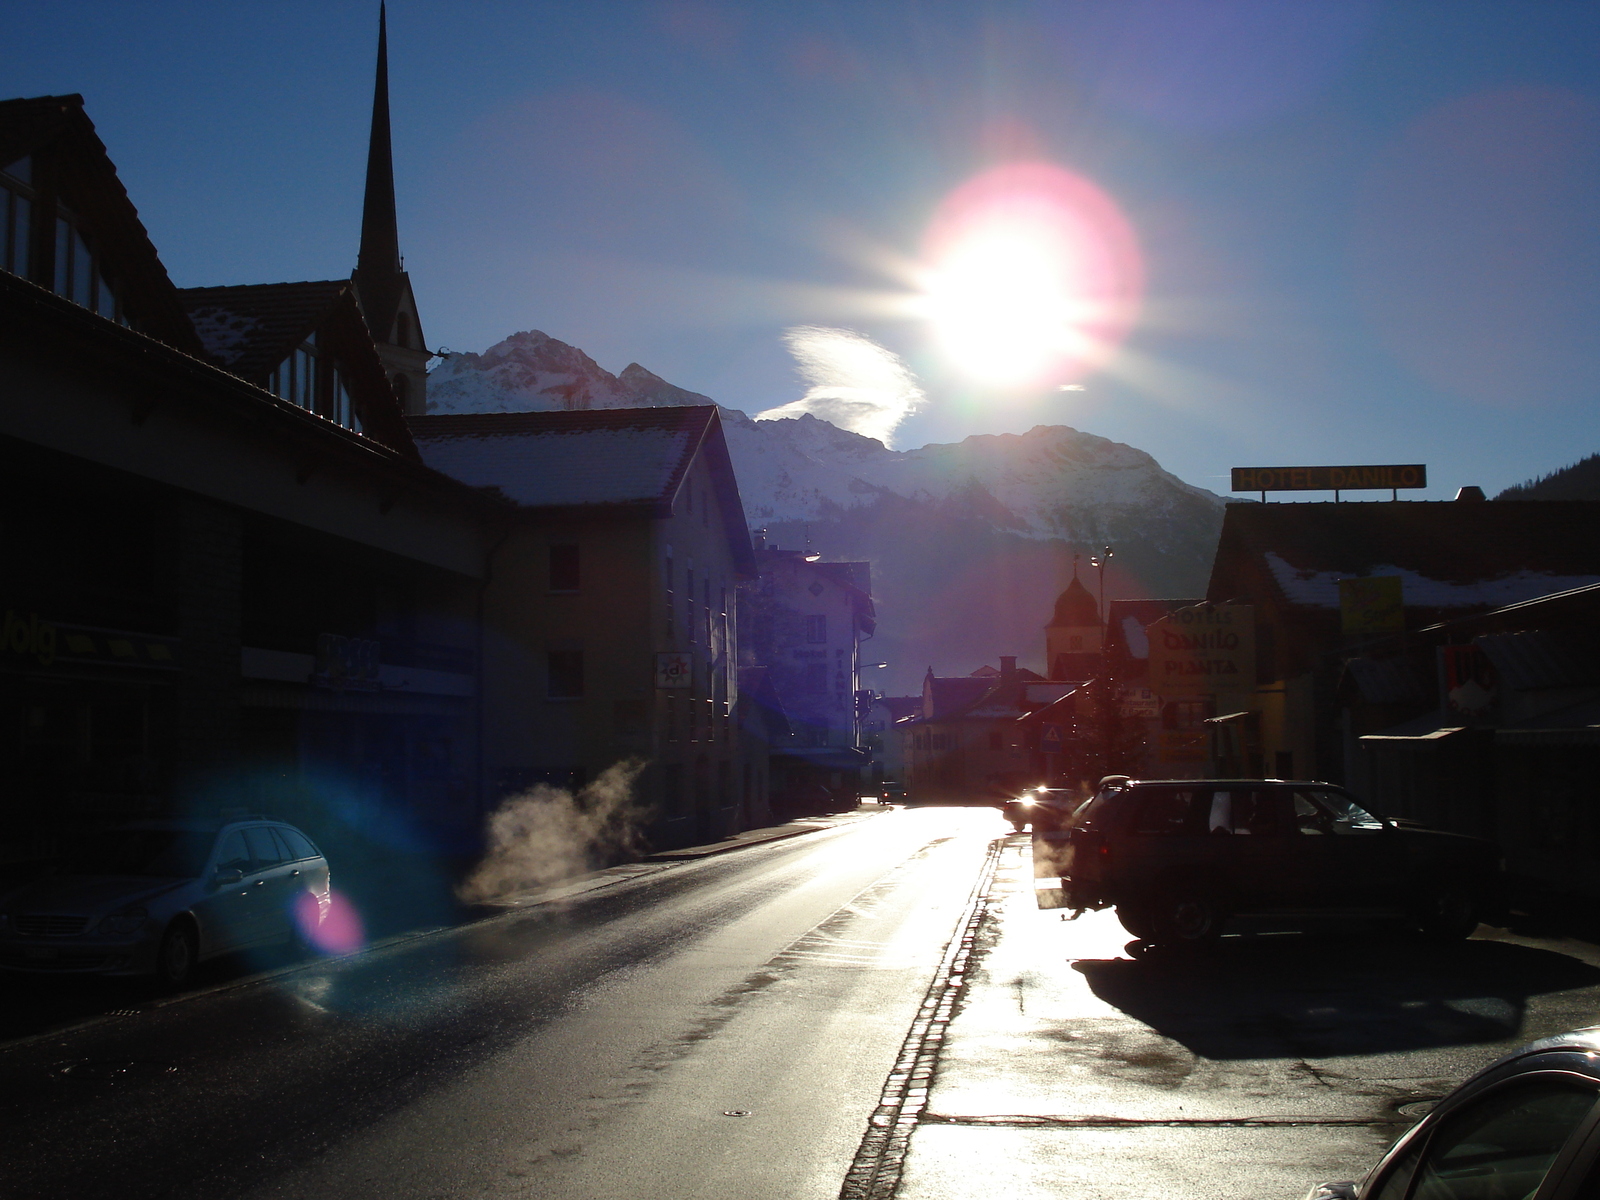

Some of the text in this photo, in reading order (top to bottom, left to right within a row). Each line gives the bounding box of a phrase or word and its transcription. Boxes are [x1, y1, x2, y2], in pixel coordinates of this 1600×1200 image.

[1240, 466, 1419, 488] HOTEL DANILO
[1168, 610, 1233, 625] HOTELS
